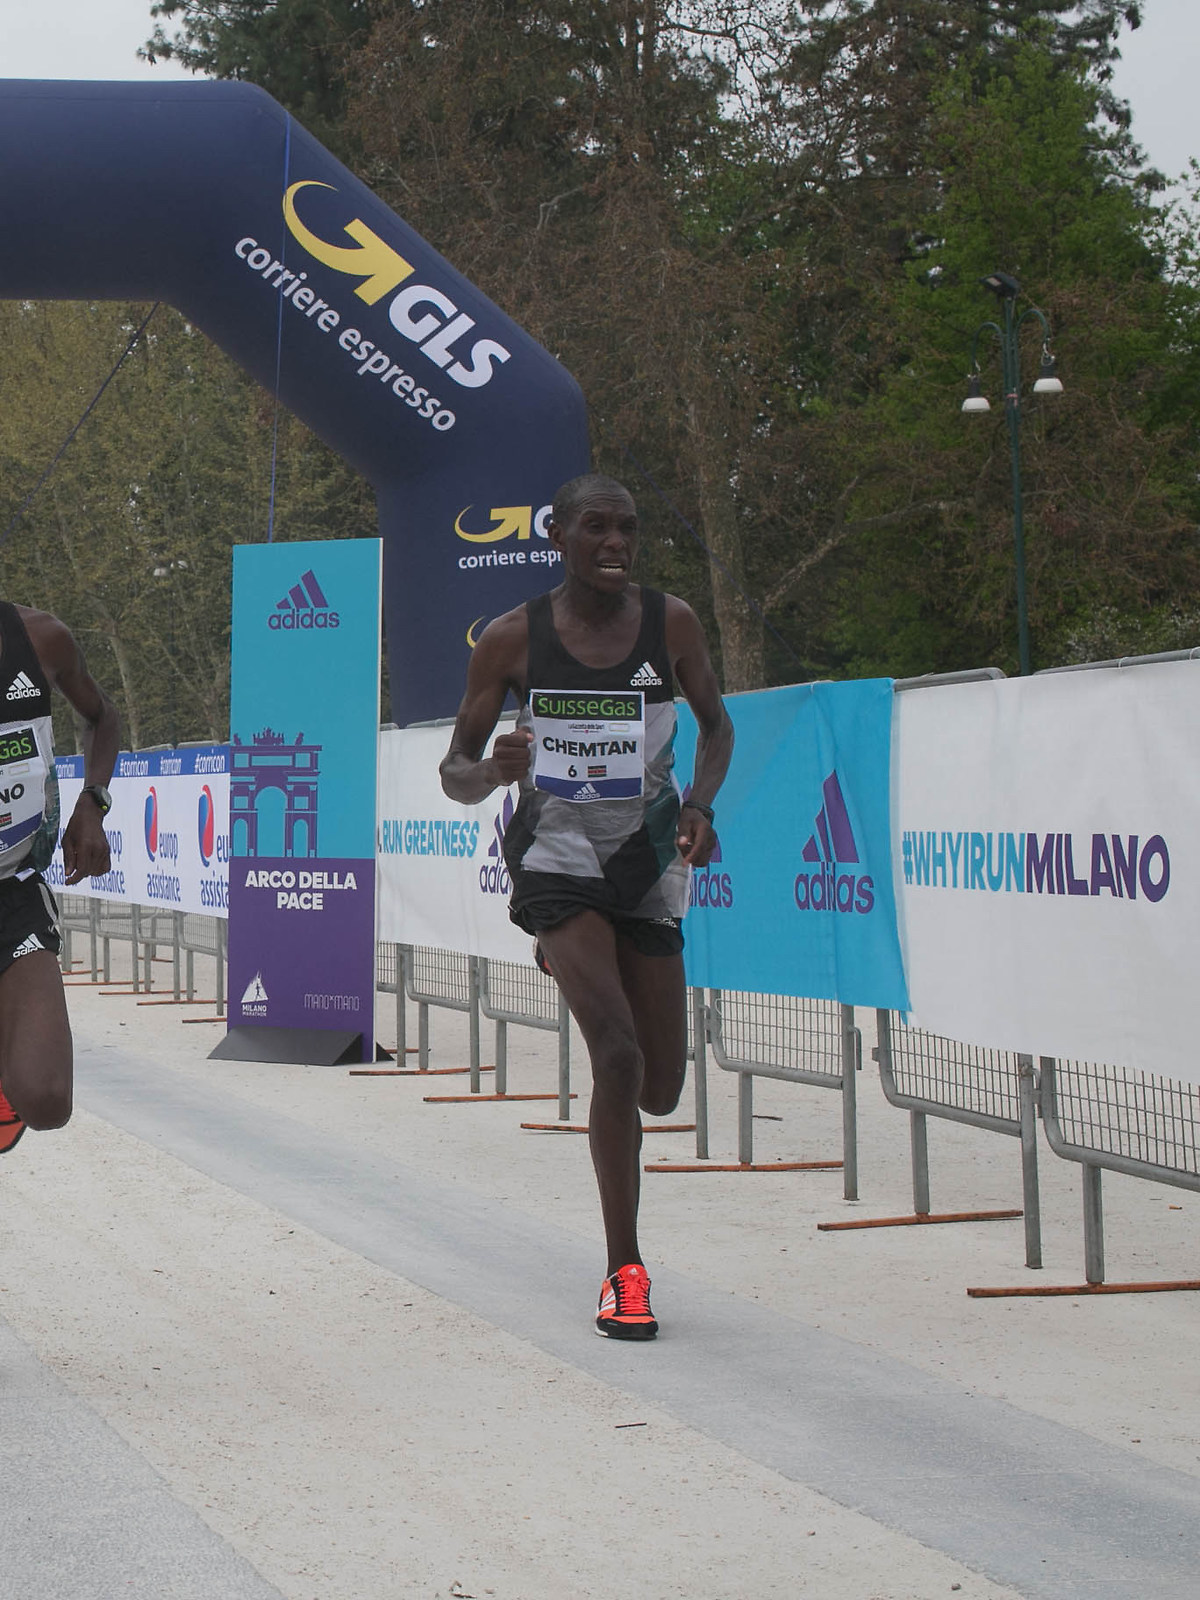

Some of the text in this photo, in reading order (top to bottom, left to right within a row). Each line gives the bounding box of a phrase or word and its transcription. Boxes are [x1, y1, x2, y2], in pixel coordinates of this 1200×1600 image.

[234, 237, 456, 432] corriere espresso
[388, 284, 512, 389] GLS
[458, 549, 562, 569] corriere espr
[267, 607, 341, 631] adidas
[631, 675, 663, 687] adidas
[6, 687, 41, 701] adidas
[542, 736, 637, 757] CHEMTAN
[568, 764, 578, 778] 6
[159, 832, 178, 866] europ
[382, 820, 480, 858] RUN GREATNESS
[902, 831, 1171, 903] #WHYIRUNMILANO
[147, 866, 181, 903] assistance
[200, 871, 229, 908] assista
[245, 870, 357, 890] ARCO DELLA
[794, 861, 875, 914] adidas
[277, 892, 324, 910] PACE
[242, 1004, 267, 1012] MILANO
